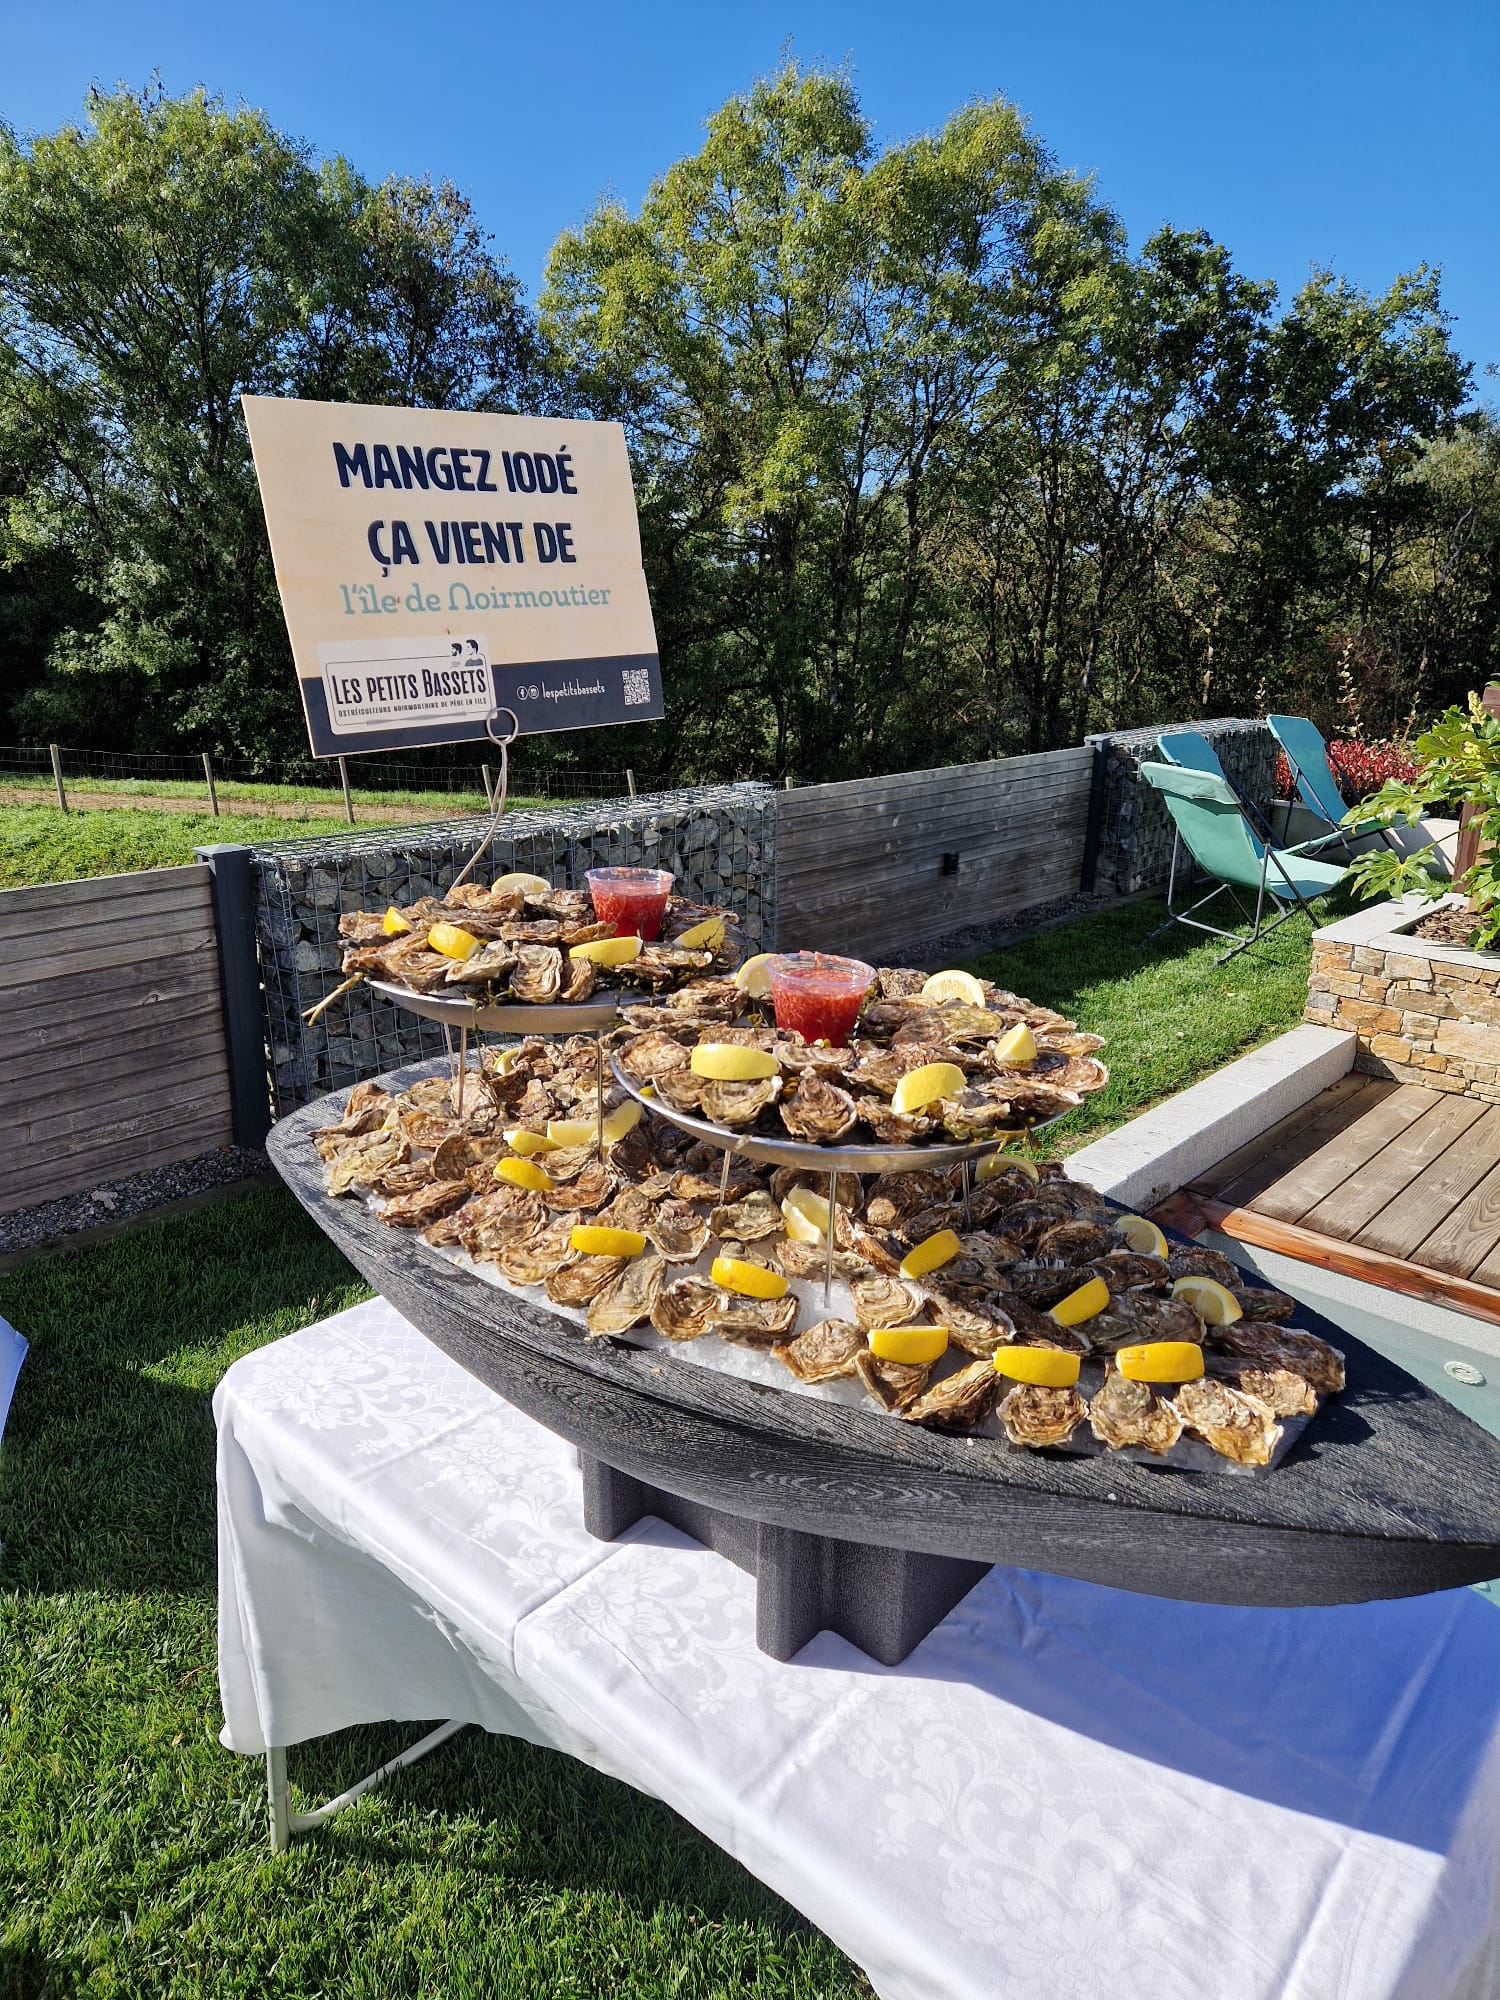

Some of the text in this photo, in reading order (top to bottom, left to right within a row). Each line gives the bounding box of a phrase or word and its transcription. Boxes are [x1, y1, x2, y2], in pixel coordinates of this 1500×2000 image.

[332, 441, 578, 495] MANGEZ IODÉ
[367, 519, 577, 577] ÇA VIENT DE
[340, 582, 611, 614] l'île de Noirmoutier
[332, 668, 487, 705] LES PETITS BASSETS
[541, 678, 606, 703] lespetitsbassets
